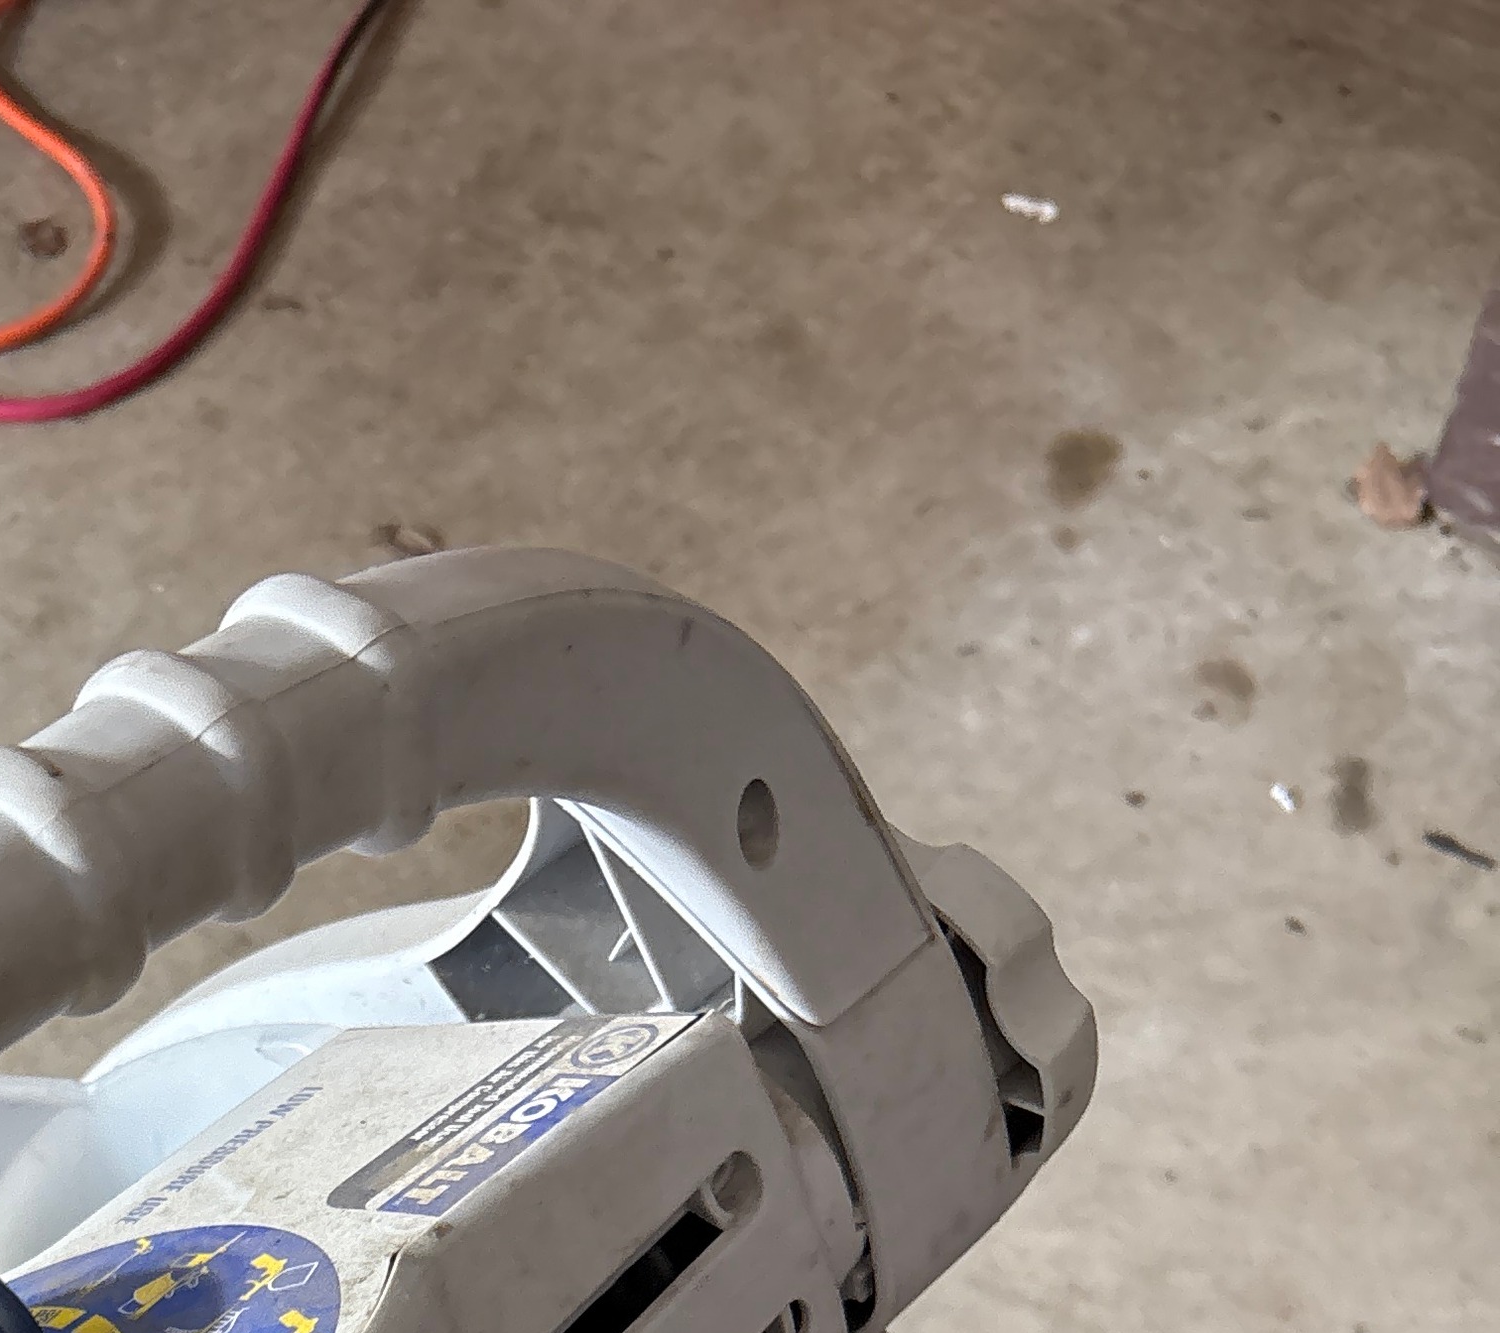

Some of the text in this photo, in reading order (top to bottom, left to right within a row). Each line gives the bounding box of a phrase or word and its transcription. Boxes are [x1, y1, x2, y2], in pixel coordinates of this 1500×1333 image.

[115, 1086, 323, 1224] LOW PRESSURE USE
[402, 1077, 592, 1205] KOBALT
